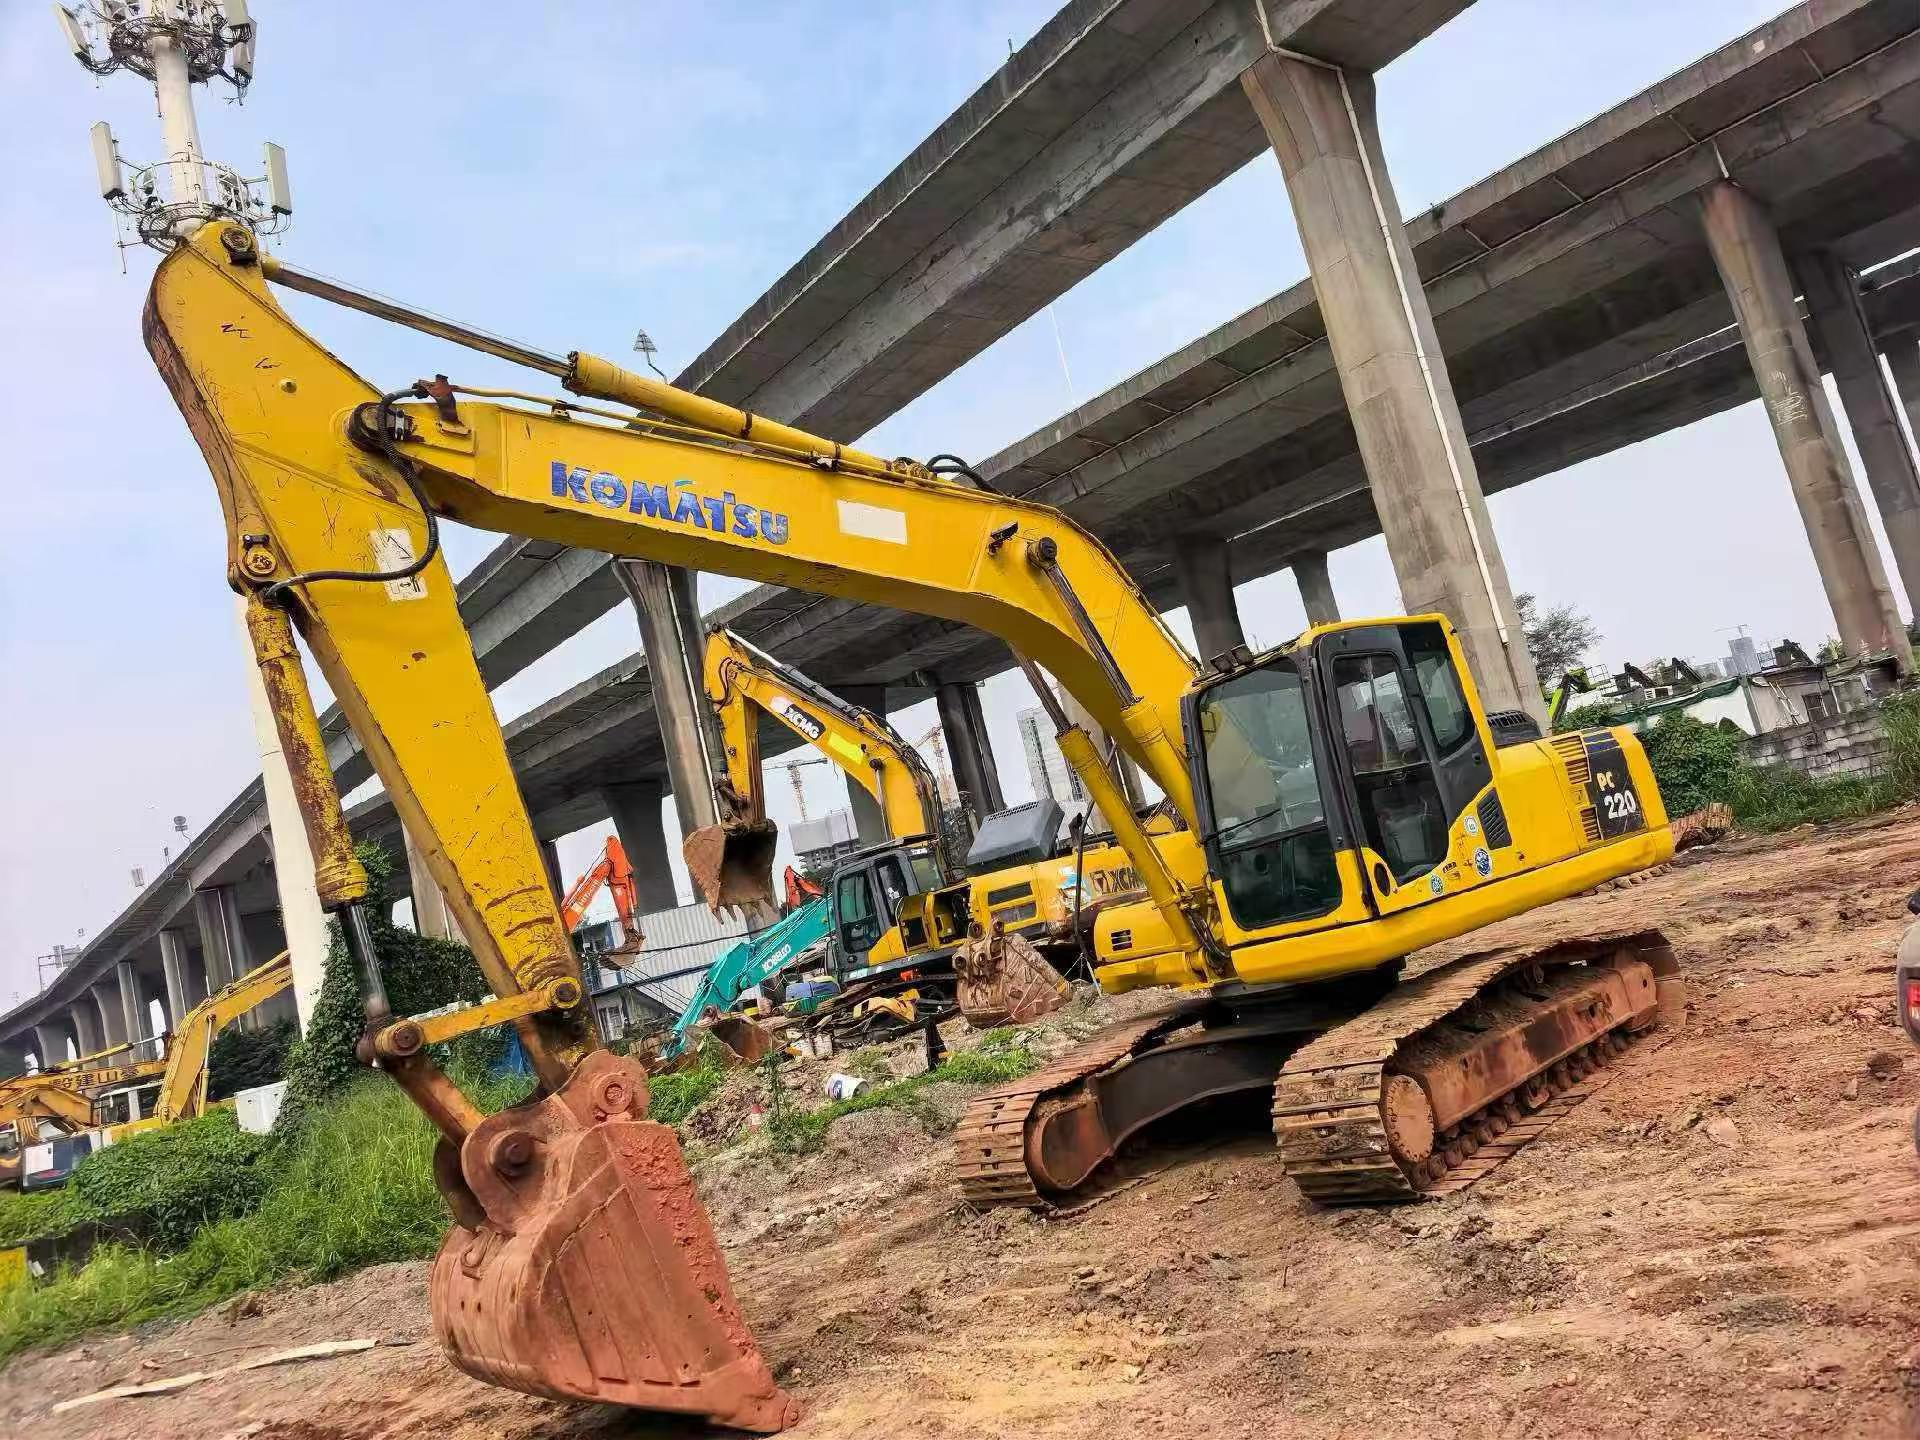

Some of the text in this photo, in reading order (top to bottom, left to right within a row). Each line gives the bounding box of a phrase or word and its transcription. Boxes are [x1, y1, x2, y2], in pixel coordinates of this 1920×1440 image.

[551, 461, 789, 546] KOMATSU
[784, 705, 820, 739] XCMG
[1596, 771, 1616, 792] PC
[1603, 789, 1637, 820] 220
